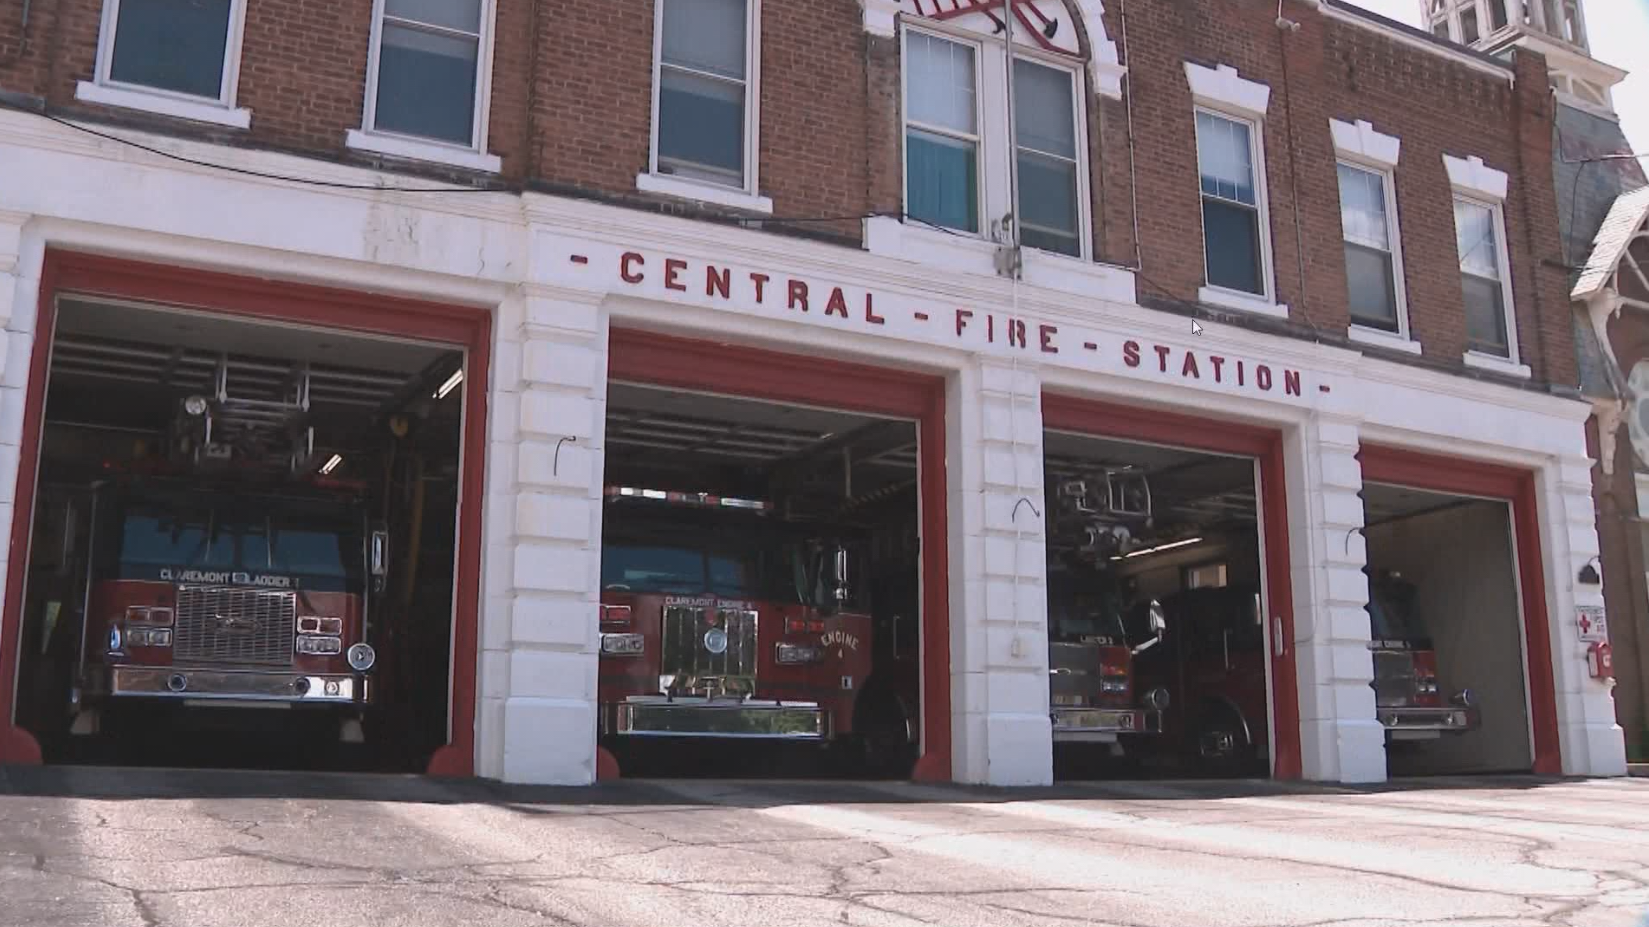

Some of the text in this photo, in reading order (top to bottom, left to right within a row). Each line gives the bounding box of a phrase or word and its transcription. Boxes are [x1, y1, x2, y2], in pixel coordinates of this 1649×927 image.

[620, 251, 885, 325] CENTRAL
[955, 308, 1059, 353] FIRE
[1123, 339, 1302, 397] STATION
[160, 568, 231, 584] CLAREMONT
[821, 630, 860, 652] ENGINE
